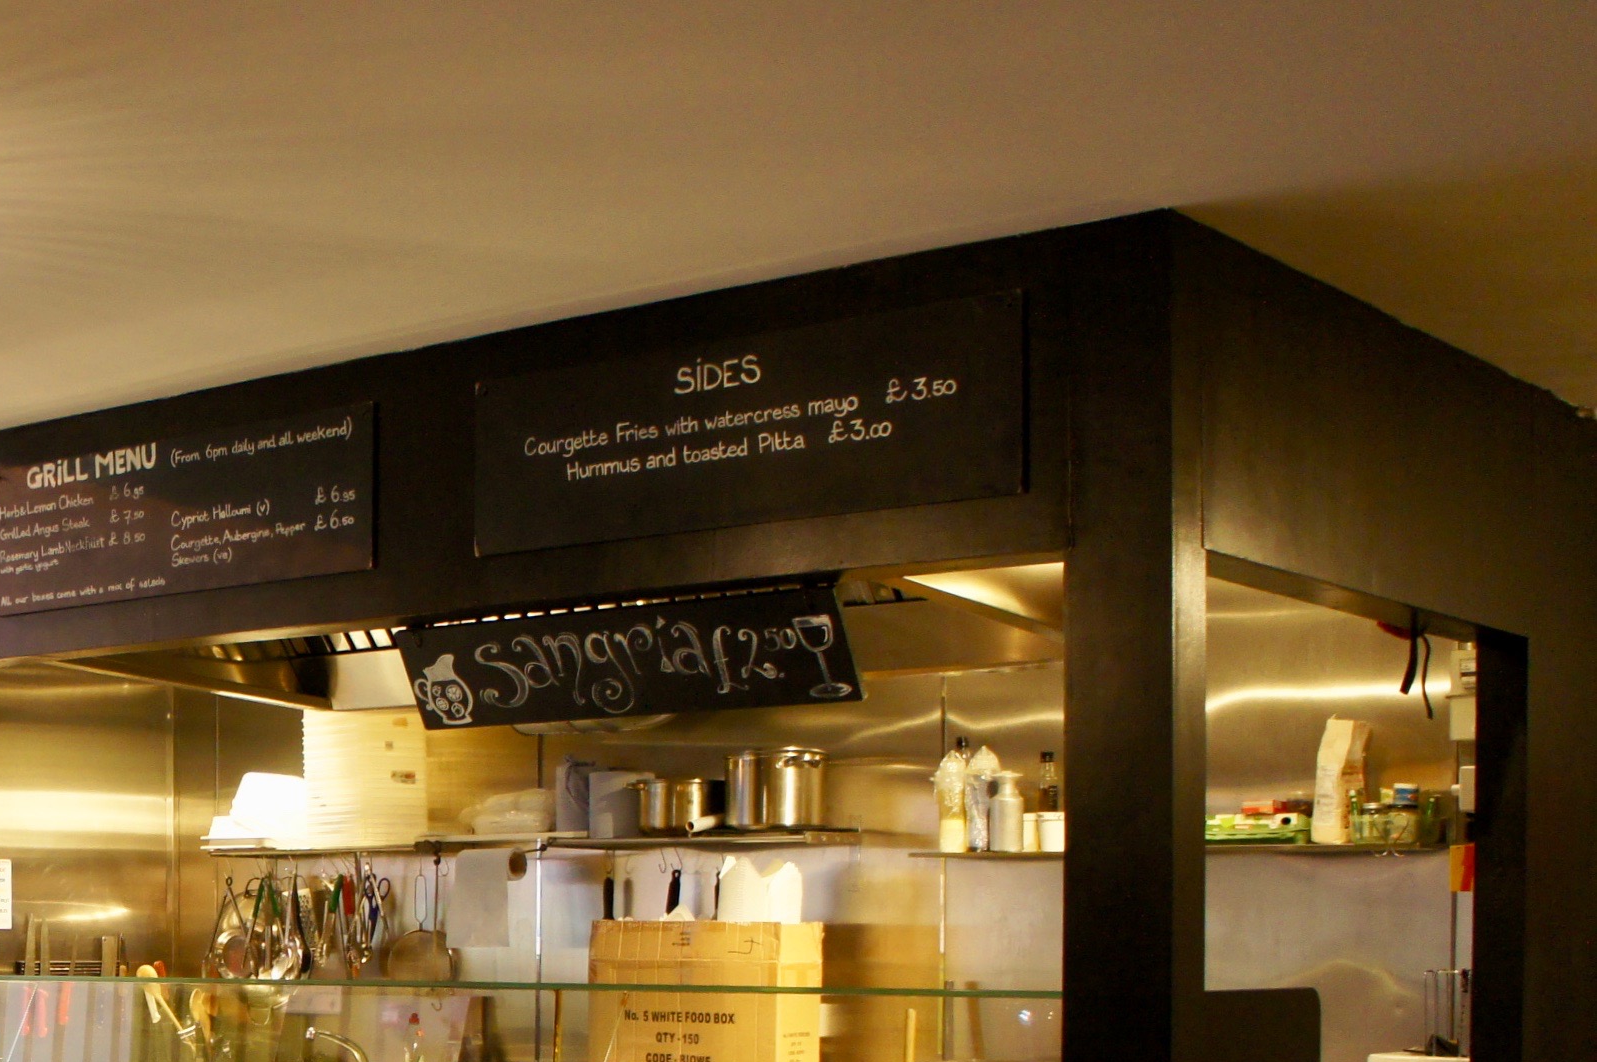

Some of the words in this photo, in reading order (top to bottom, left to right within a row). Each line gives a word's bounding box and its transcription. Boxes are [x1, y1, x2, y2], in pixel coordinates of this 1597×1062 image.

[524, 429, 609, 457] Courgette
[615, 420, 659, 444] Fries
[665, 415, 699, 437] with
[704, 404, 801, 431] watercress
[808, 394, 859, 425] mayo
[171, 447, 201, 468] (From
[205, 443, 228, 461] 6pm
[231, 438, 255, 455] daily
[257, 434, 277, 450] and
[278, 430, 294, 447] all
[296, 415, 352, 442] weekend)
[95, 442, 157, 479] MENU
[566, 456, 640, 482] Hummus
[646, 446, 677, 471] and
[683, 437, 748, 465] toasted
[758, 430, 805, 455] Pitta
[58, 494, 94, 511] Chicken
[0, 525, 32, 541] Grilled
[33, 522, 60, 538] Angus
[61, 516, 91, 531] Steak
[171, 510, 210, 530] Cypriot
[213, 503, 252, 520] Halloumi
[0, 550, 39, 564] Rosemary
[643, 1010, 650, 1022] 5
[651, 1010, 683, 1023] WHITE
[684, 1011, 711, 1024] FOOD
[713, 1012, 736, 1025] BOX
[655, 1031, 675, 1044] QTY
[682, 1032, 700, 1045] 150
